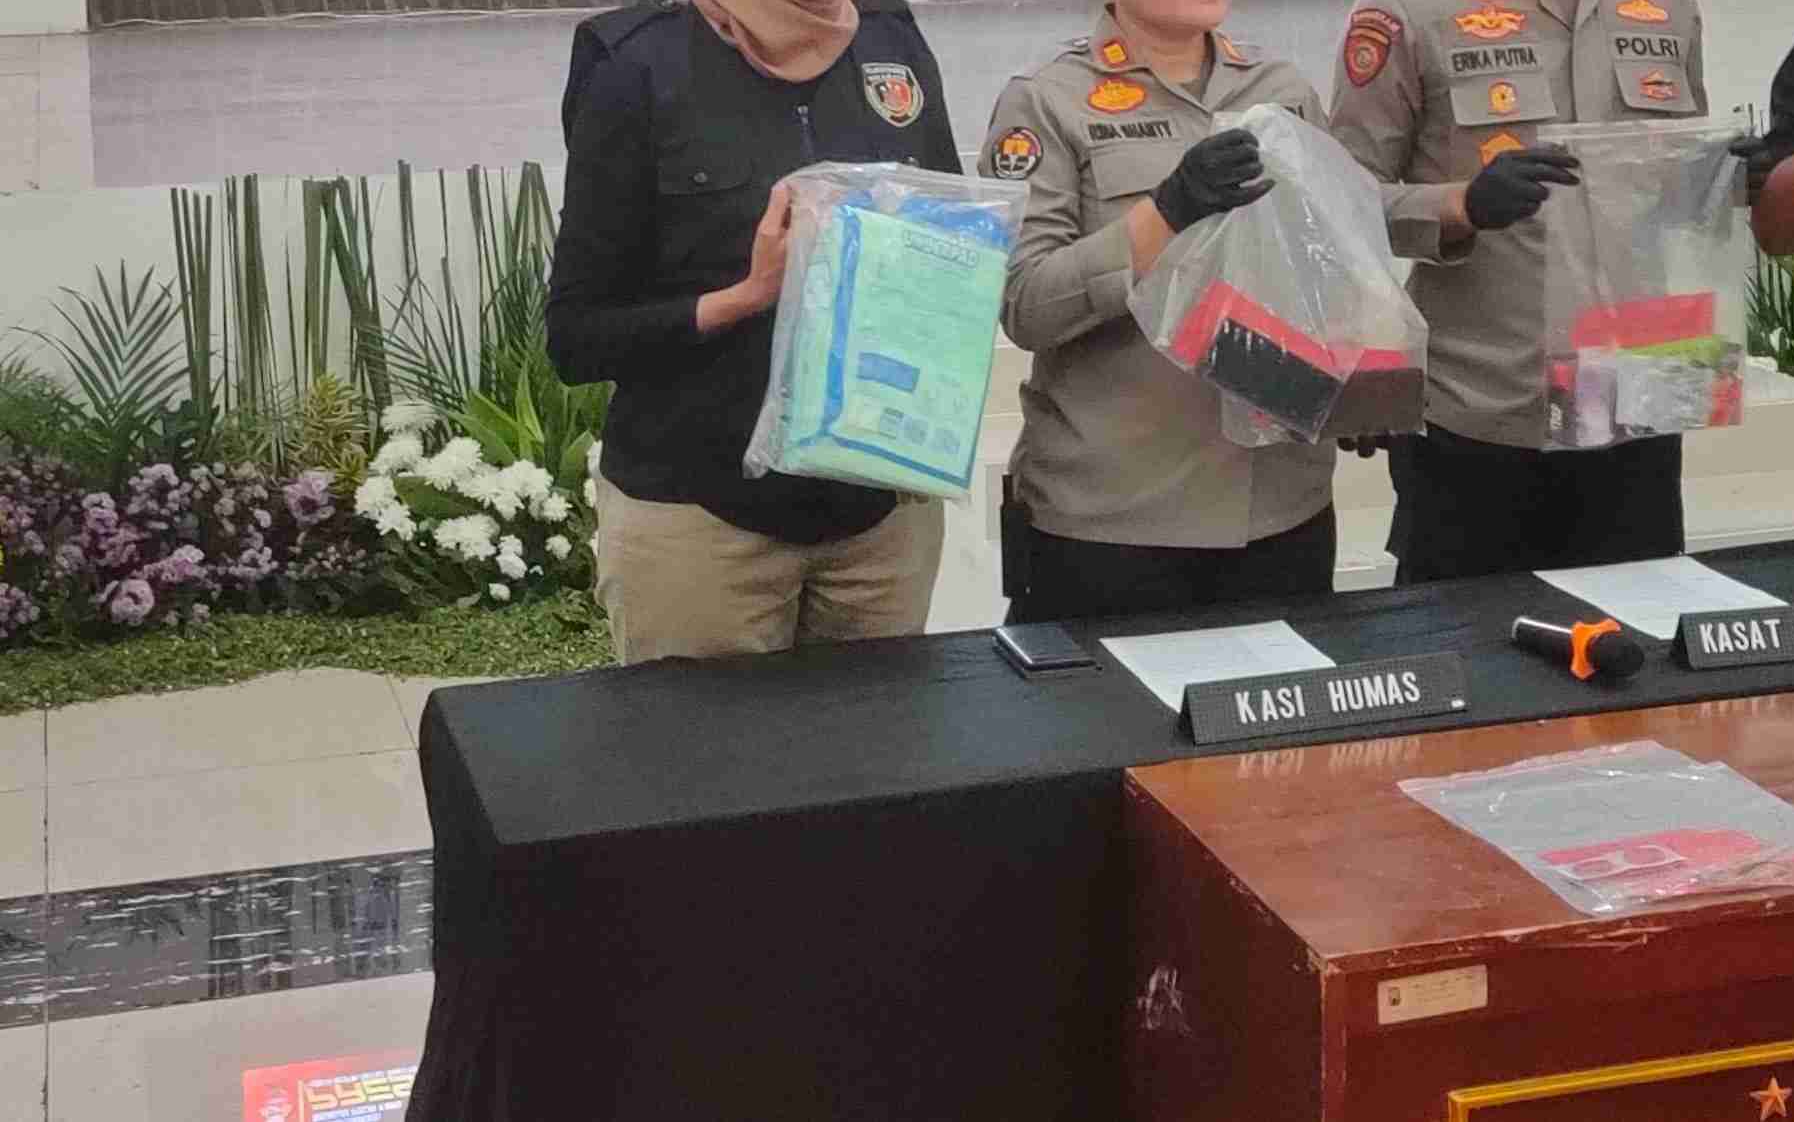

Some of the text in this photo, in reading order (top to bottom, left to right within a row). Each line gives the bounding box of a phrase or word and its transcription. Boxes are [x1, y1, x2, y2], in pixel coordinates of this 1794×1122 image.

[1451, 46, 1537, 72] ERIKA PUTRA
[1615, 37, 1680, 59] POLRI
[1699, 618, 1781, 654] KASAT
[1235, 672, 1421, 724] KASI HUMAS
